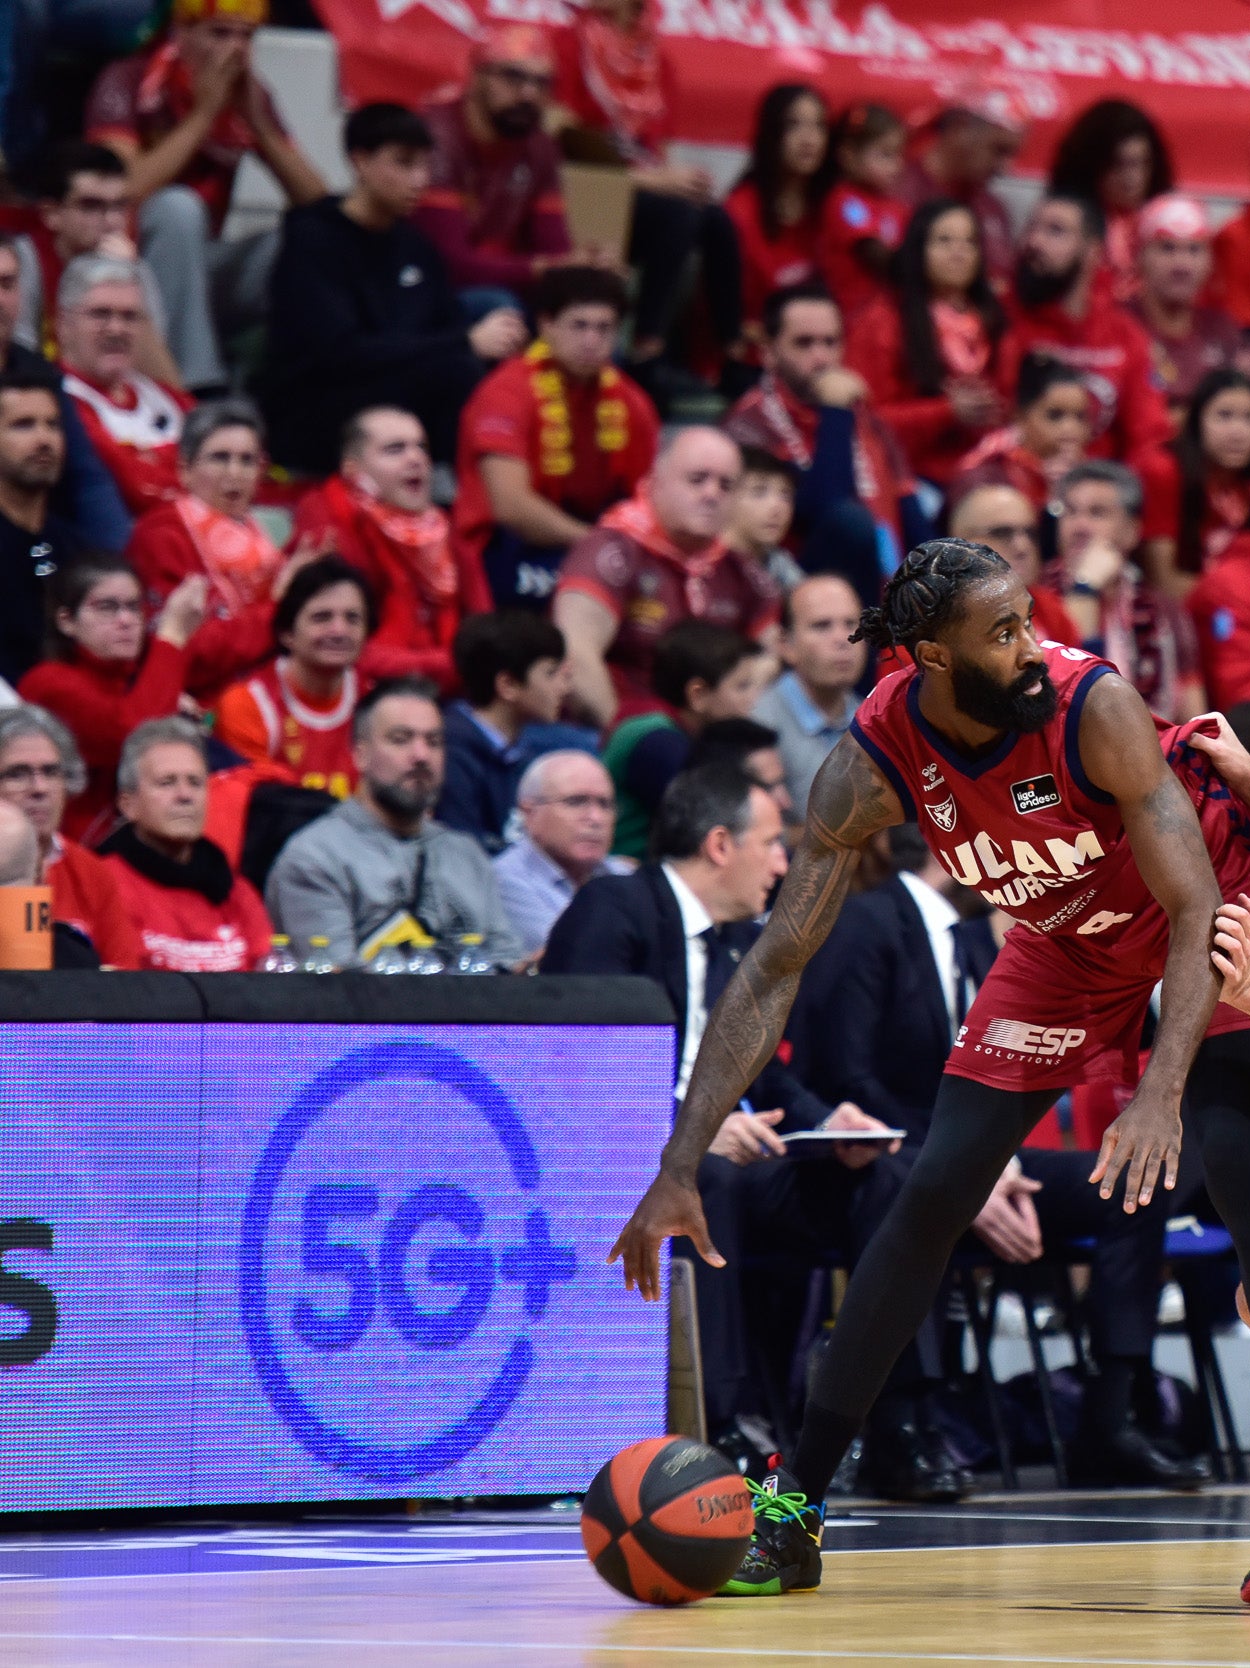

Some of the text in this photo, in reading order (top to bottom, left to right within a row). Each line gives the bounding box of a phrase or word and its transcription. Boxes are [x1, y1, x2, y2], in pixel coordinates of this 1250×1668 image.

[1017, 790, 1036, 802] liga
[1019, 793, 1058, 809] endesa
[939, 830, 1106, 886] UCAM
[1012, 1022, 1087, 1056] ESP
[974, 1044, 1061, 1066] SOLUTIONS
